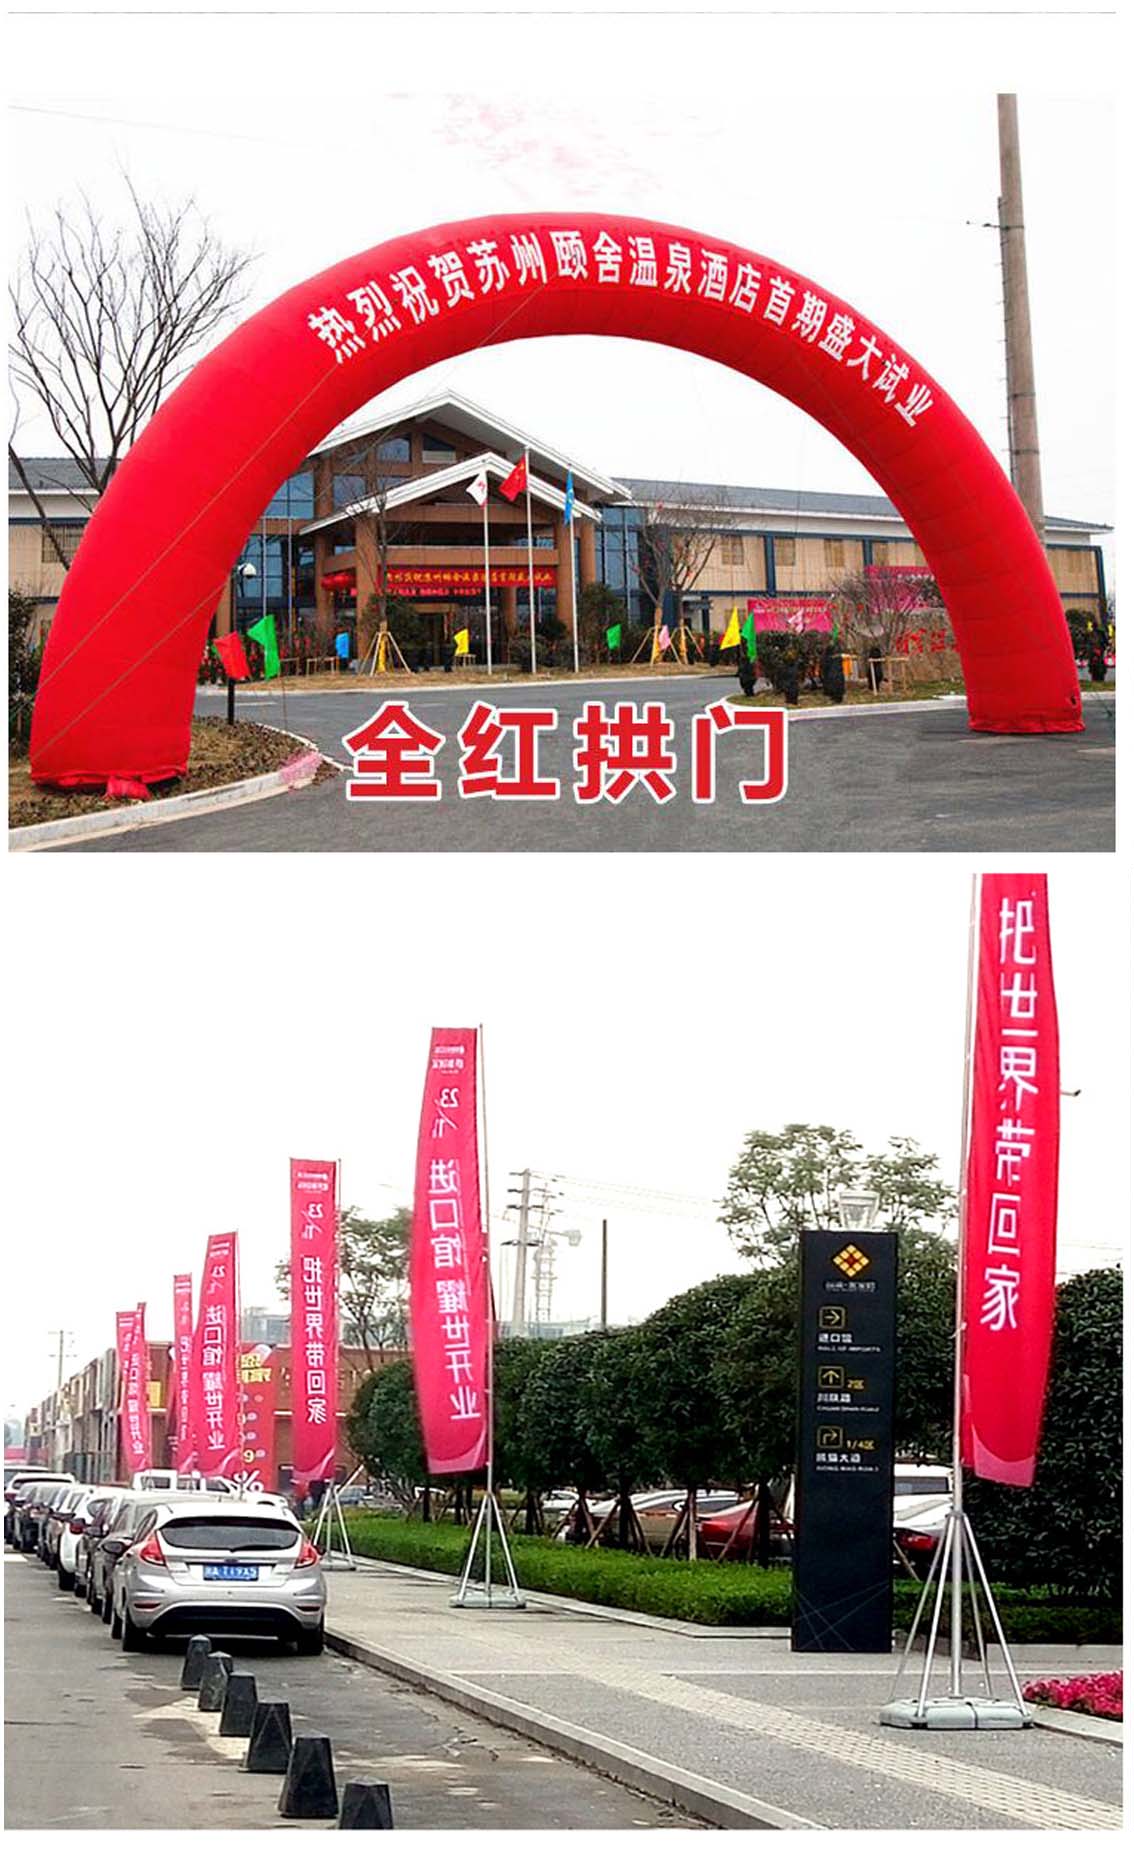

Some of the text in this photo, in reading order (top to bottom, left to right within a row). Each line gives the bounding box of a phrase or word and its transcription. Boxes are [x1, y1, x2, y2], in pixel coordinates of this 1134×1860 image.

[307, 229, 934, 429] 热烈祝贺苏州颐舍温泉酒店首期盛大试业
[980, 898, 1039, 1332] 把世界带回家
